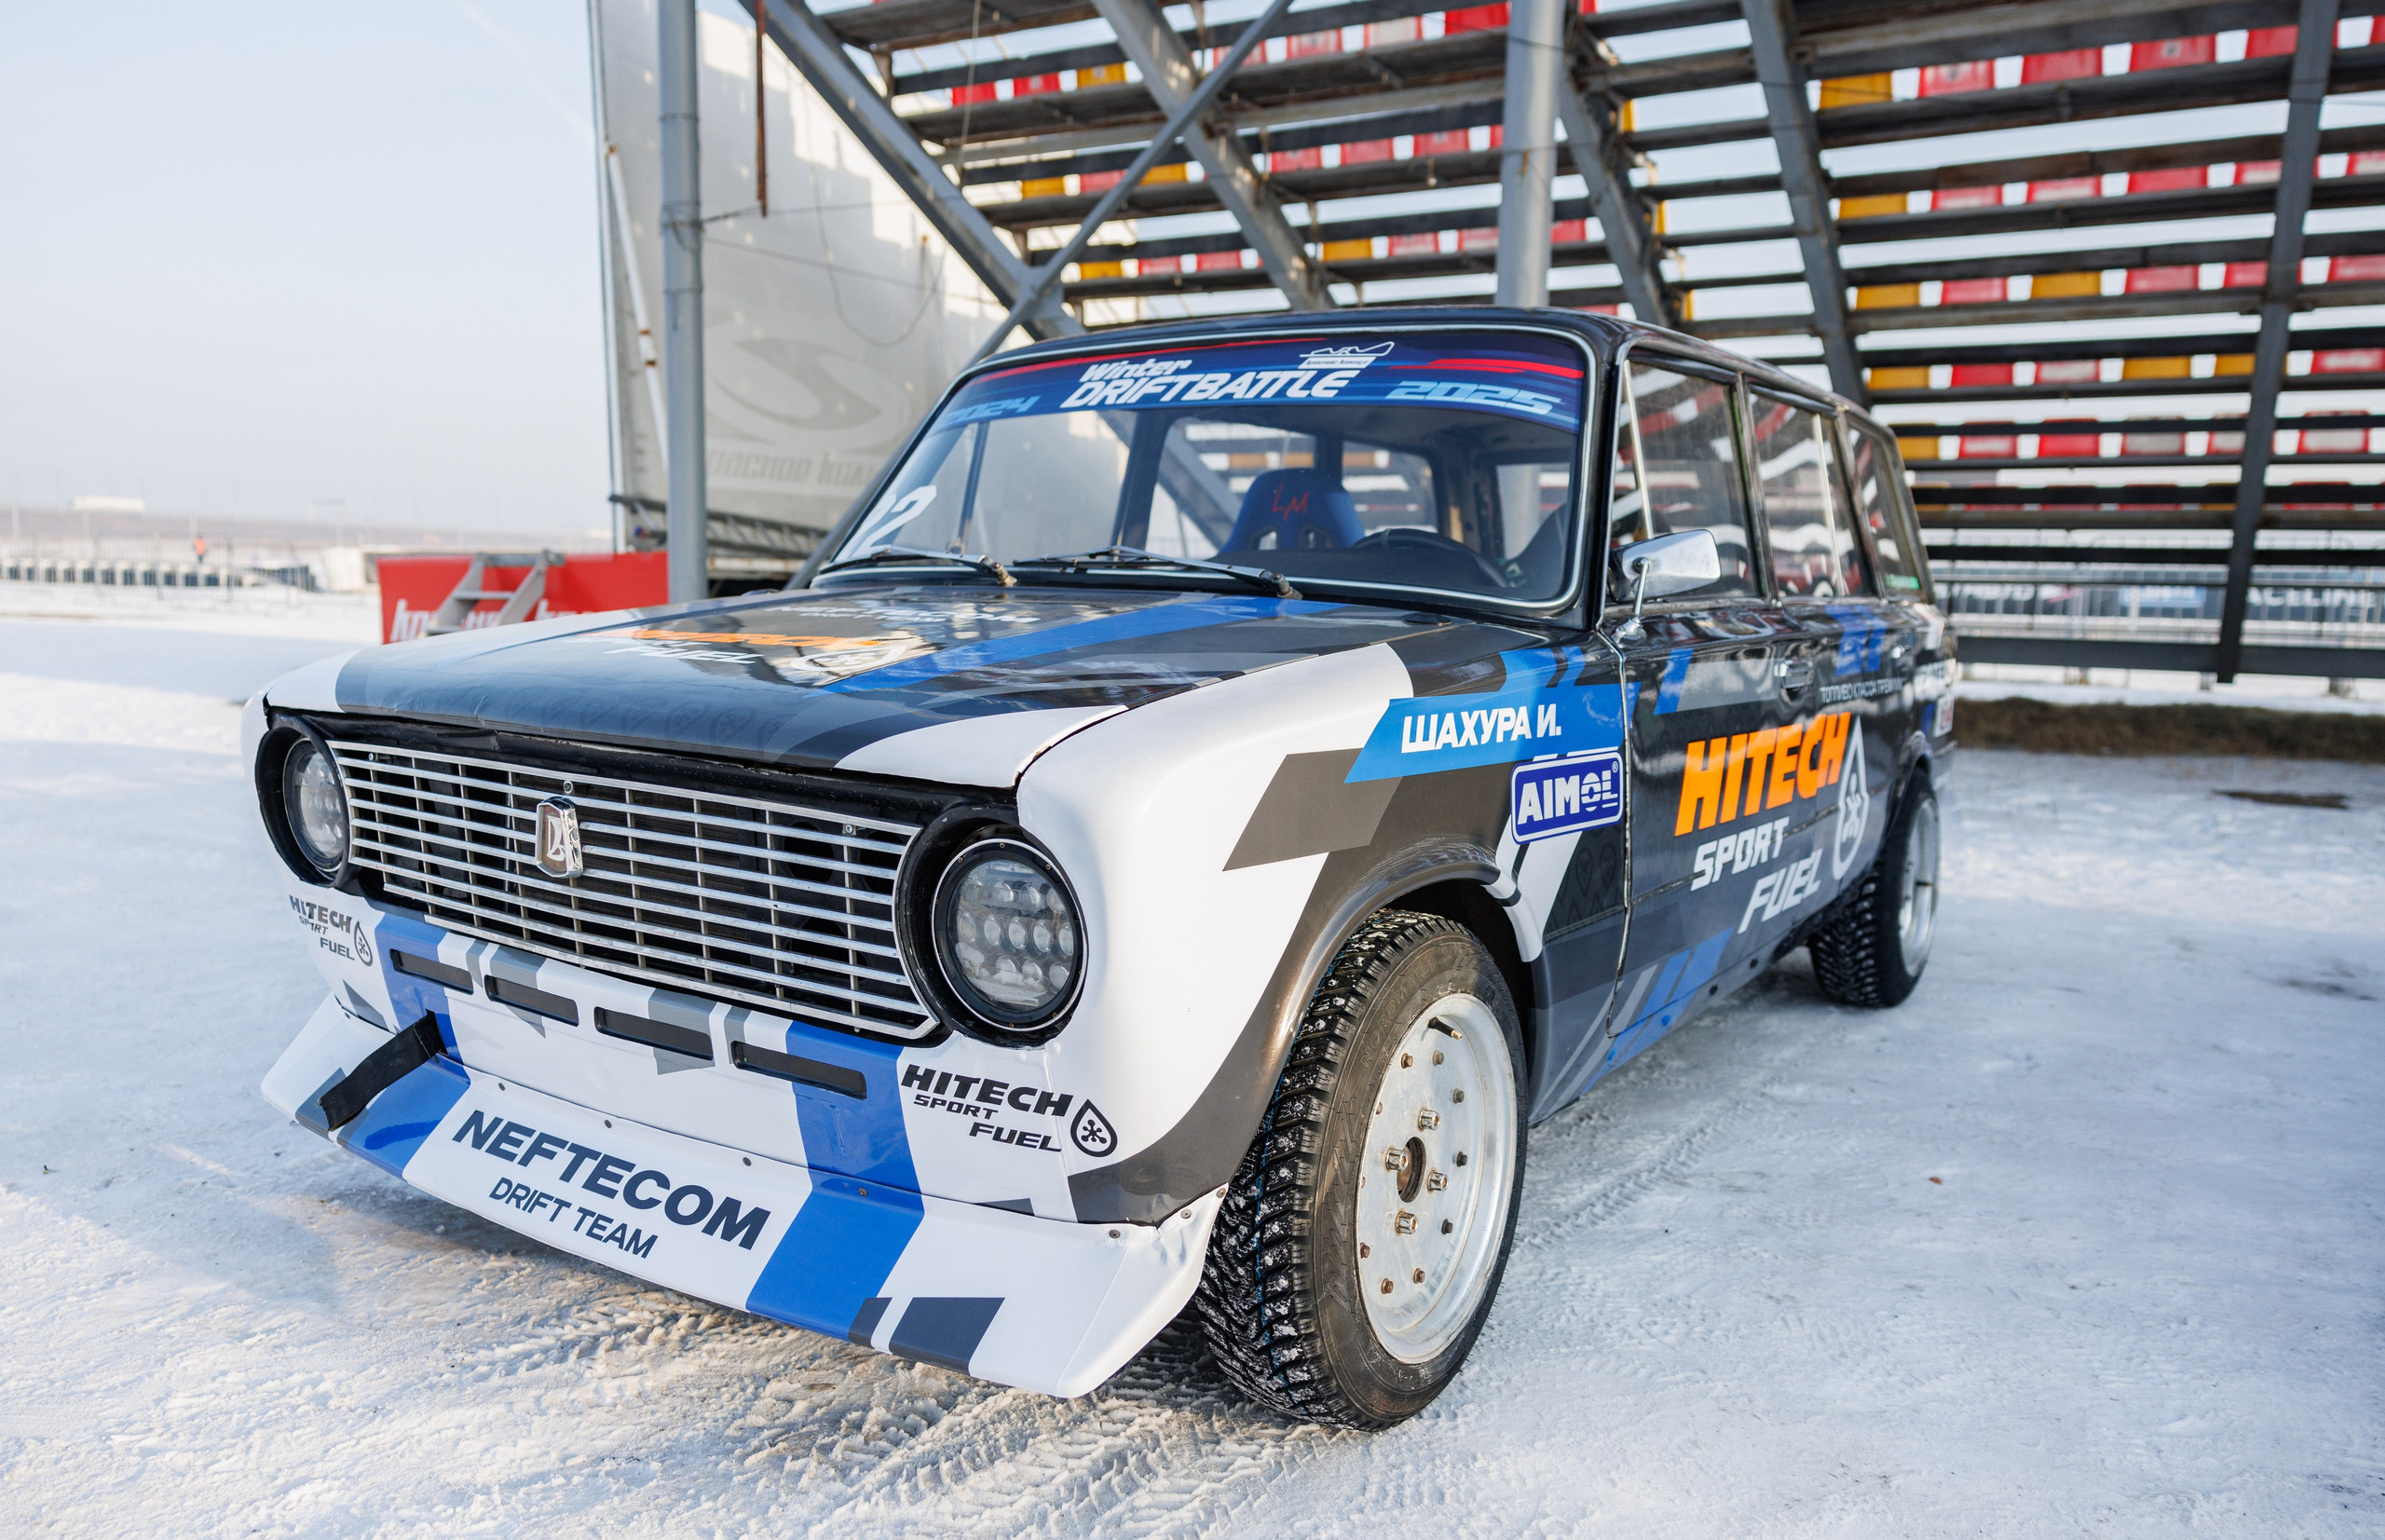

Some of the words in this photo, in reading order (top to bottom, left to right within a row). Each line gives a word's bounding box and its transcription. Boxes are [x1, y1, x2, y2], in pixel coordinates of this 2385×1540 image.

[1058, 369, 1362, 408] DRIFTBATTLE
[1081, 359, 1192, 382] Winter
[1385, 380, 1563, 416] 2025
[1401, 705, 1532, 754] ШАХУРА
[1535, 703, 1562, 740] И.
[1674, 712, 1851, 837] HITECH
[1690, 816, 1790, 893] SPORT
[1738, 848, 1823, 934] FUEL
[289, 894, 353, 934] HITECH
[320, 936, 355, 961] FUEL
[900, 1063, 1074, 1117] HITECH
[914, 1094, 999, 1121] SPORT
[969, 1122, 1063, 1153] FUEL
[452, 1110, 771, 1251] NEFTECOM
[488, 1177, 575, 1223] DRIFT
[573, 1206, 659, 1260] TEAM
